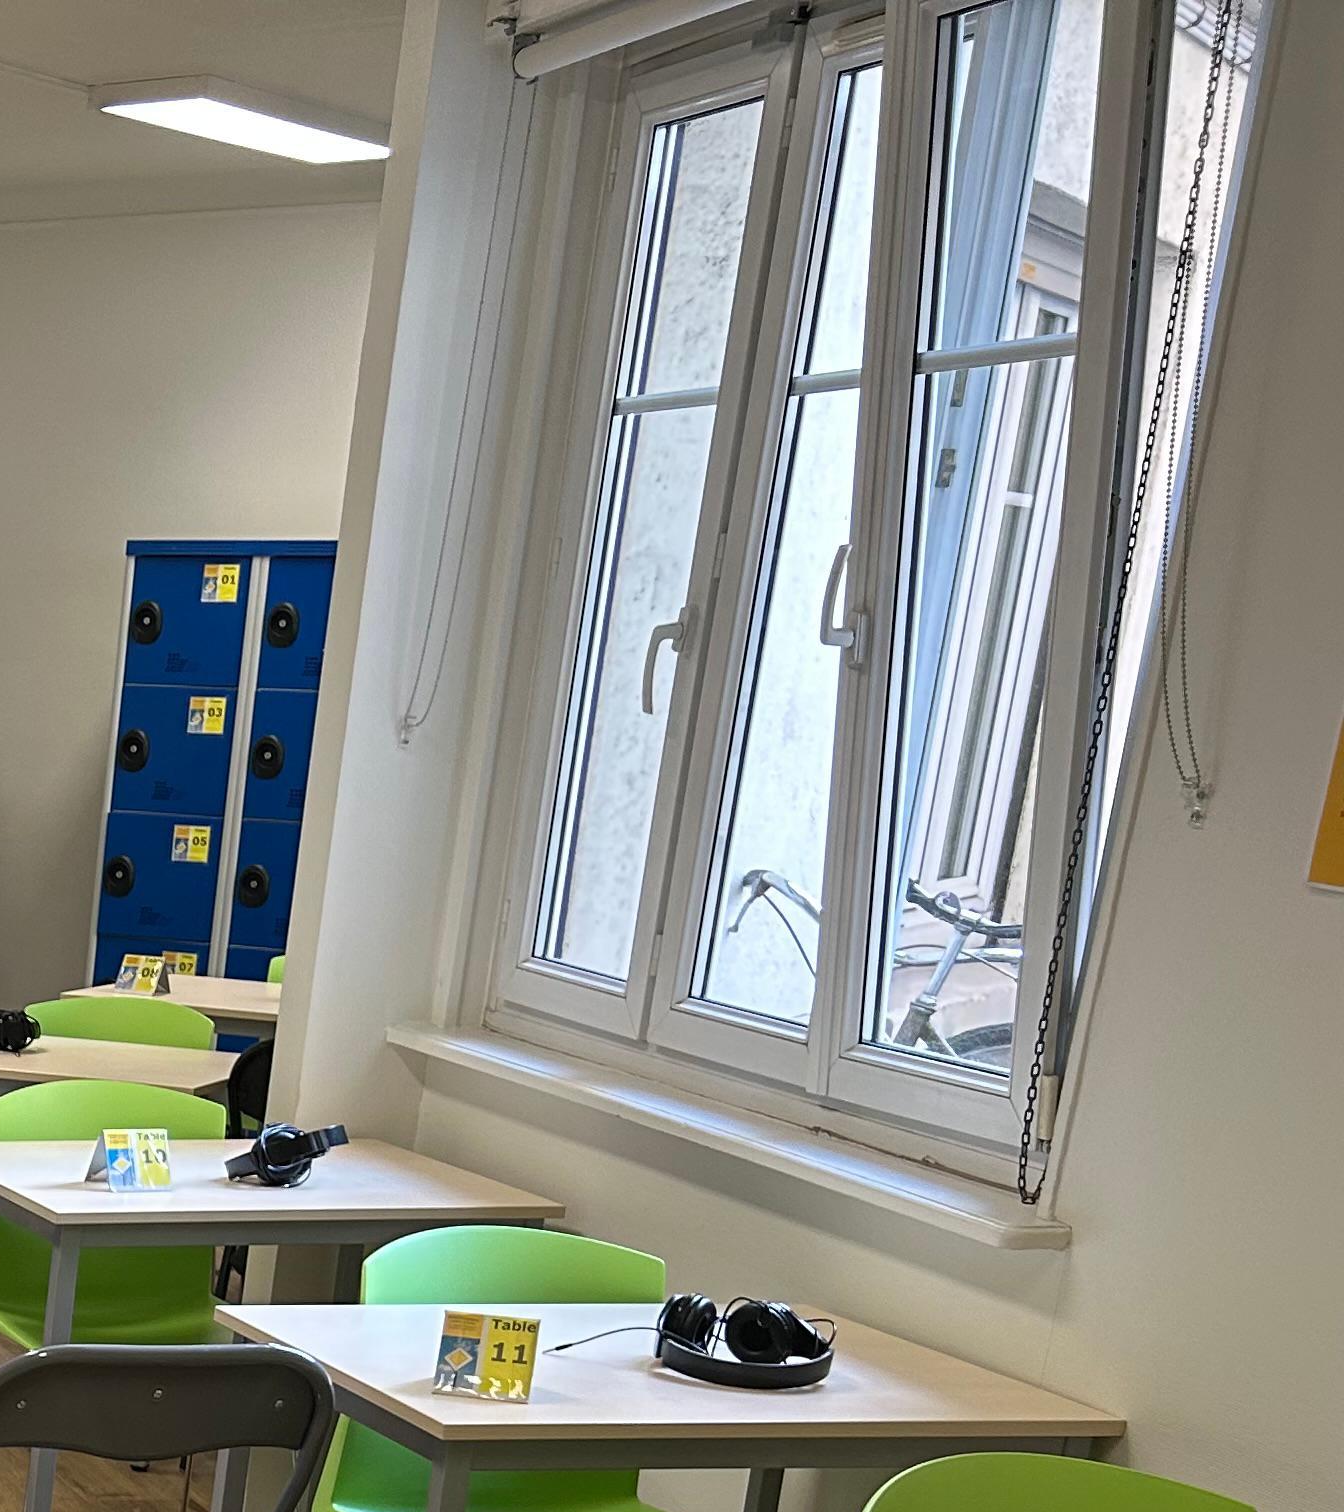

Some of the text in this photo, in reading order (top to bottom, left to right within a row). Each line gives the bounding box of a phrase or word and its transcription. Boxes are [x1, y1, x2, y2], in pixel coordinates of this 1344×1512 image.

[222, 575, 236, 584] 01
[208, 708, 222, 717] 03
[192, 836, 207, 847] 05
[179, 962, 193, 972] 07
[142, 1148, 167, 1164] 10
[492, 1318, 537, 1333] Table
[491, 1342, 528, 1365] 11
